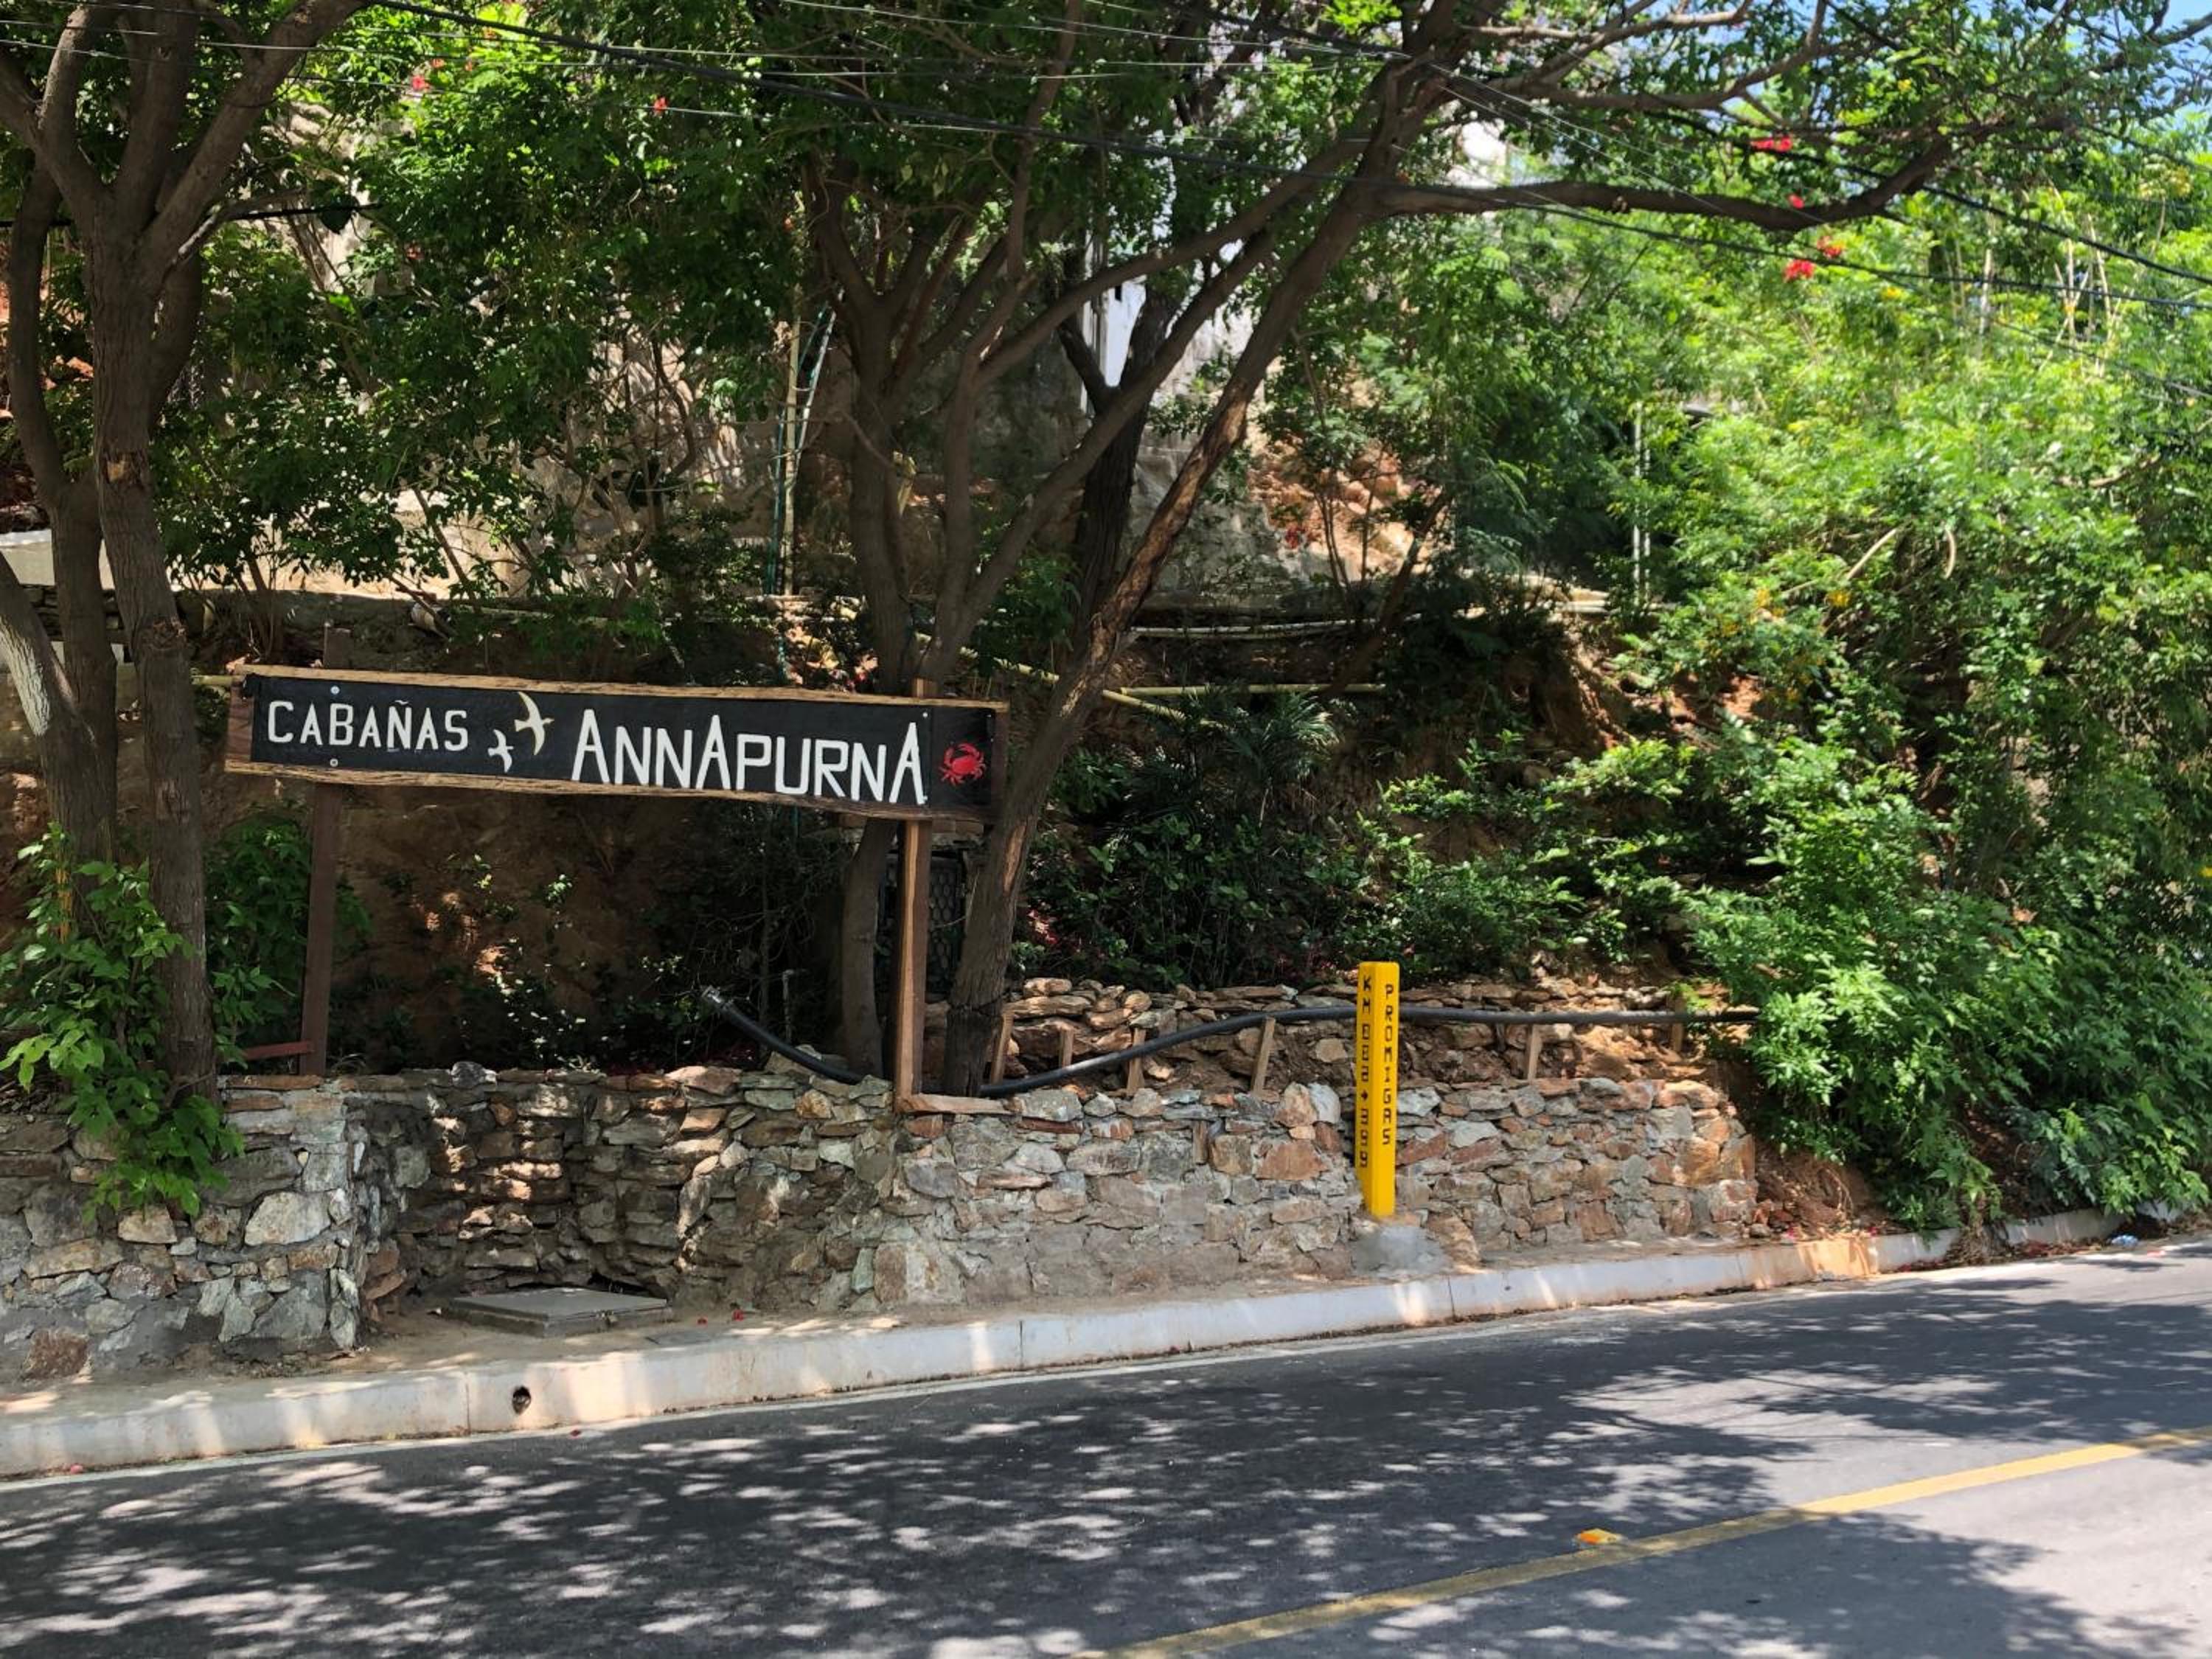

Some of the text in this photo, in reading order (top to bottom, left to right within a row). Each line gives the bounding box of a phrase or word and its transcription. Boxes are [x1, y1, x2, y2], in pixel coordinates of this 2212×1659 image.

[268, 699, 928, 805] CABAÑAS ANNAPURNA
[1382, 984, 1394, 1145] PROMIGAS
